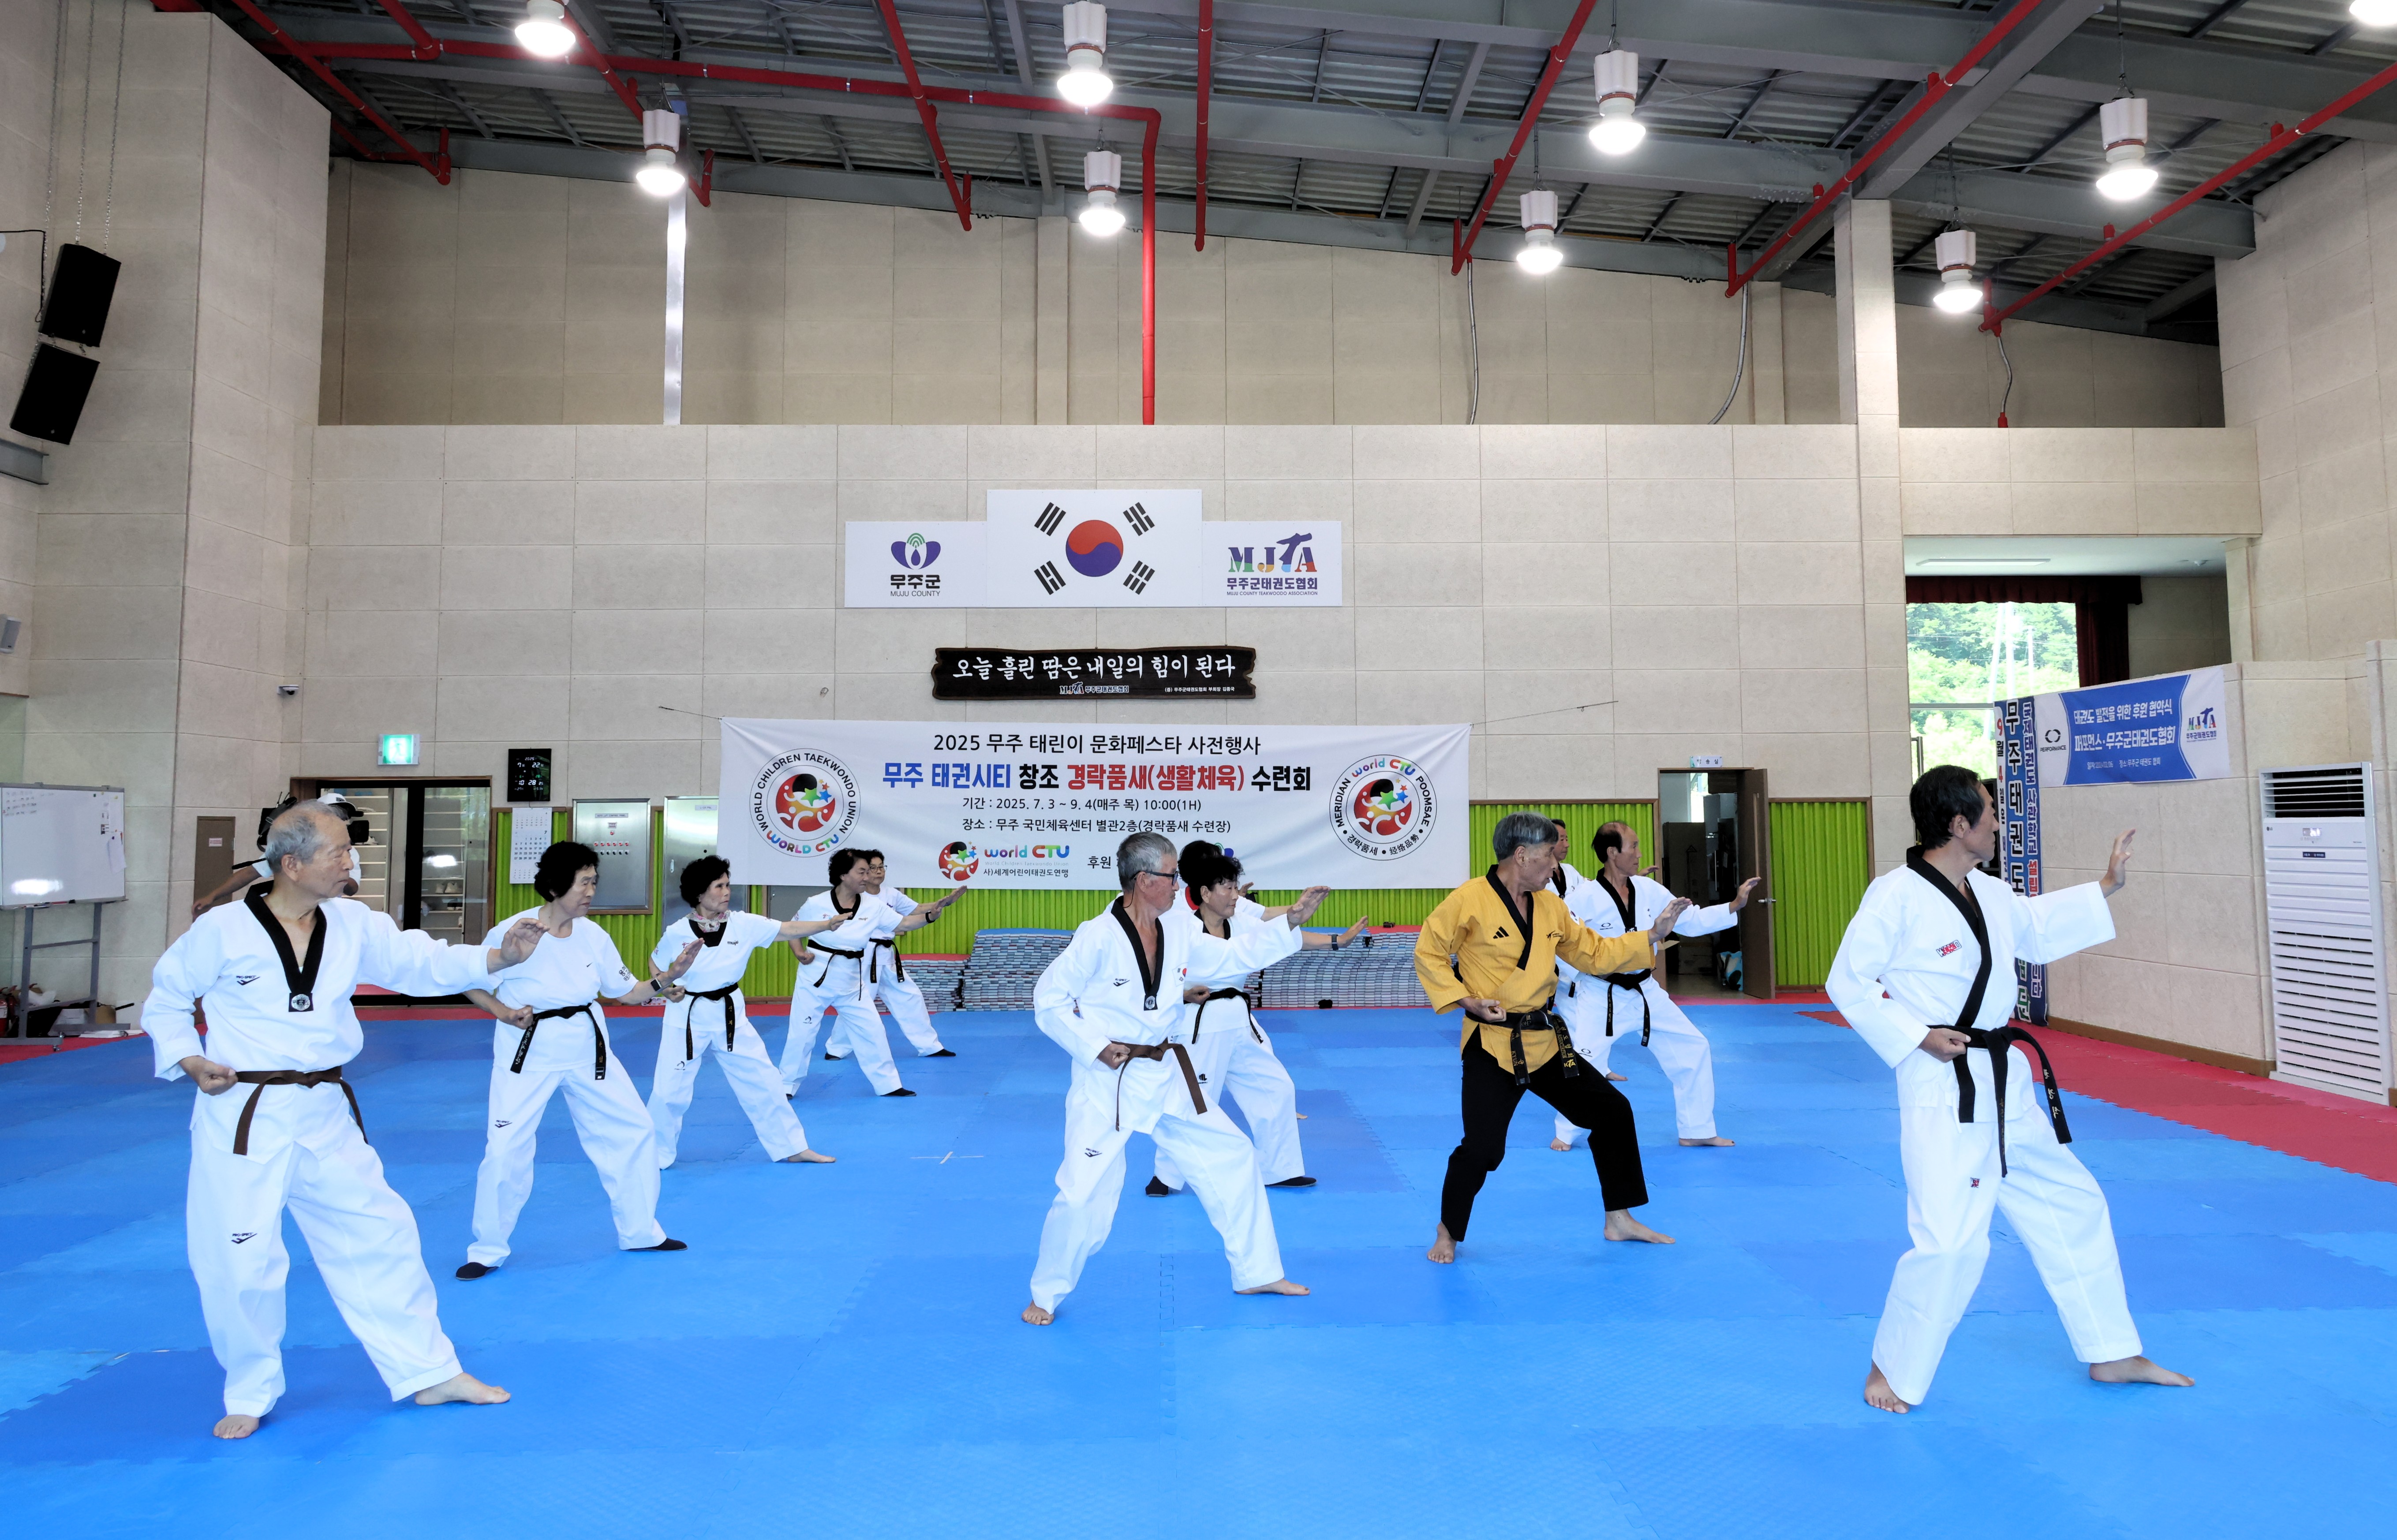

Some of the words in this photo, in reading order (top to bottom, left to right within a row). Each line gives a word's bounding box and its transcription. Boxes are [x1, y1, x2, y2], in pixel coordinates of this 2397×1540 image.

[1228, 533, 1317, 573] MJTA
[890, 575, 940, 589] 무주군
[1227, 577, 1317, 590] 무주군태권도협회
[953, 656, 993, 680] 오늘
[997, 656, 1034, 680] 흘린
[1042, 656, 1081, 680] 땀은
[1086, 655, 1143, 680] 내일의
[1151, 655, 1187, 679] 힘이
[1195, 654, 1235, 678] 된다
[1085, 685, 1129, 694] 무주군태권도협회
[2074, 708, 2094, 725] 태권도
[2096, 706, 2115, 723] 발전을
[2117, 704, 2131, 720] 위한
[2133, 702, 2148, 719] 후원
[2149, 699, 2173, 718] 협약식
[934, 735, 980, 751] 2025
[986, 734, 1023, 753] 무주
[1029, 734, 1083, 754] 태린이
[1090, 735, 1182, 755] 문화페스타
[1188, 736, 1261, 755] 사전행사
[757, 754, 801, 789] CHILDREN
[804, 753, 856, 797] TAEKWONDO
[883, 763, 924, 789] 무주
[931, 763, 1011, 789] 태권시티
[1019, 764, 1059, 790] 창조
[1067, 764, 1244, 791] 경락품새(생활체육)
[1251, 766, 1310, 792] 수련회
[1352, 757, 1385, 777] world
[1390, 759, 1416, 776] CTU
[754, 792, 769, 831] WORLD
[962, 797, 985, 810] 기간
[996, 799, 1029, 810] 2025.
[1033, 799, 1044, 810] 7.
[1048, 799, 1055, 810] 3
[1070, 799, 1081, 810] 9.
[1085, 798, 1120, 811] 4(매주
[1123, 799, 1139, 811] 목)
[1144, 799, 1201, 811] 10:00(1H)
[1334, 777, 1351, 828] MERIDIAN
[1415, 776, 1432, 826] POOMSAE
[839, 801, 856, 834] UNION
[962, 819, 985, 830] 장소
[996, 819, 1019, 831] 무주
[1023, 819, 1092, 832] 국민체육센터
[1096, 819, 1189, 833] 별관2층(경락품새
[1192, 820, 1231, 833] 수련장)
[766, 830, 811, 854] WORLD
[815, 834, 839, 852] CTU
[984, 845, 1027, 858] world
[1032, 845, 1069, 858] CTU
[1347, 834, 1378, 856] 경락품세
[983, 868, 1069, 878] 사)세계어린이태권도연맹
[1087, 856, 1111, 869] 후원
[1563, 1059, 1576, 1068] KTA
